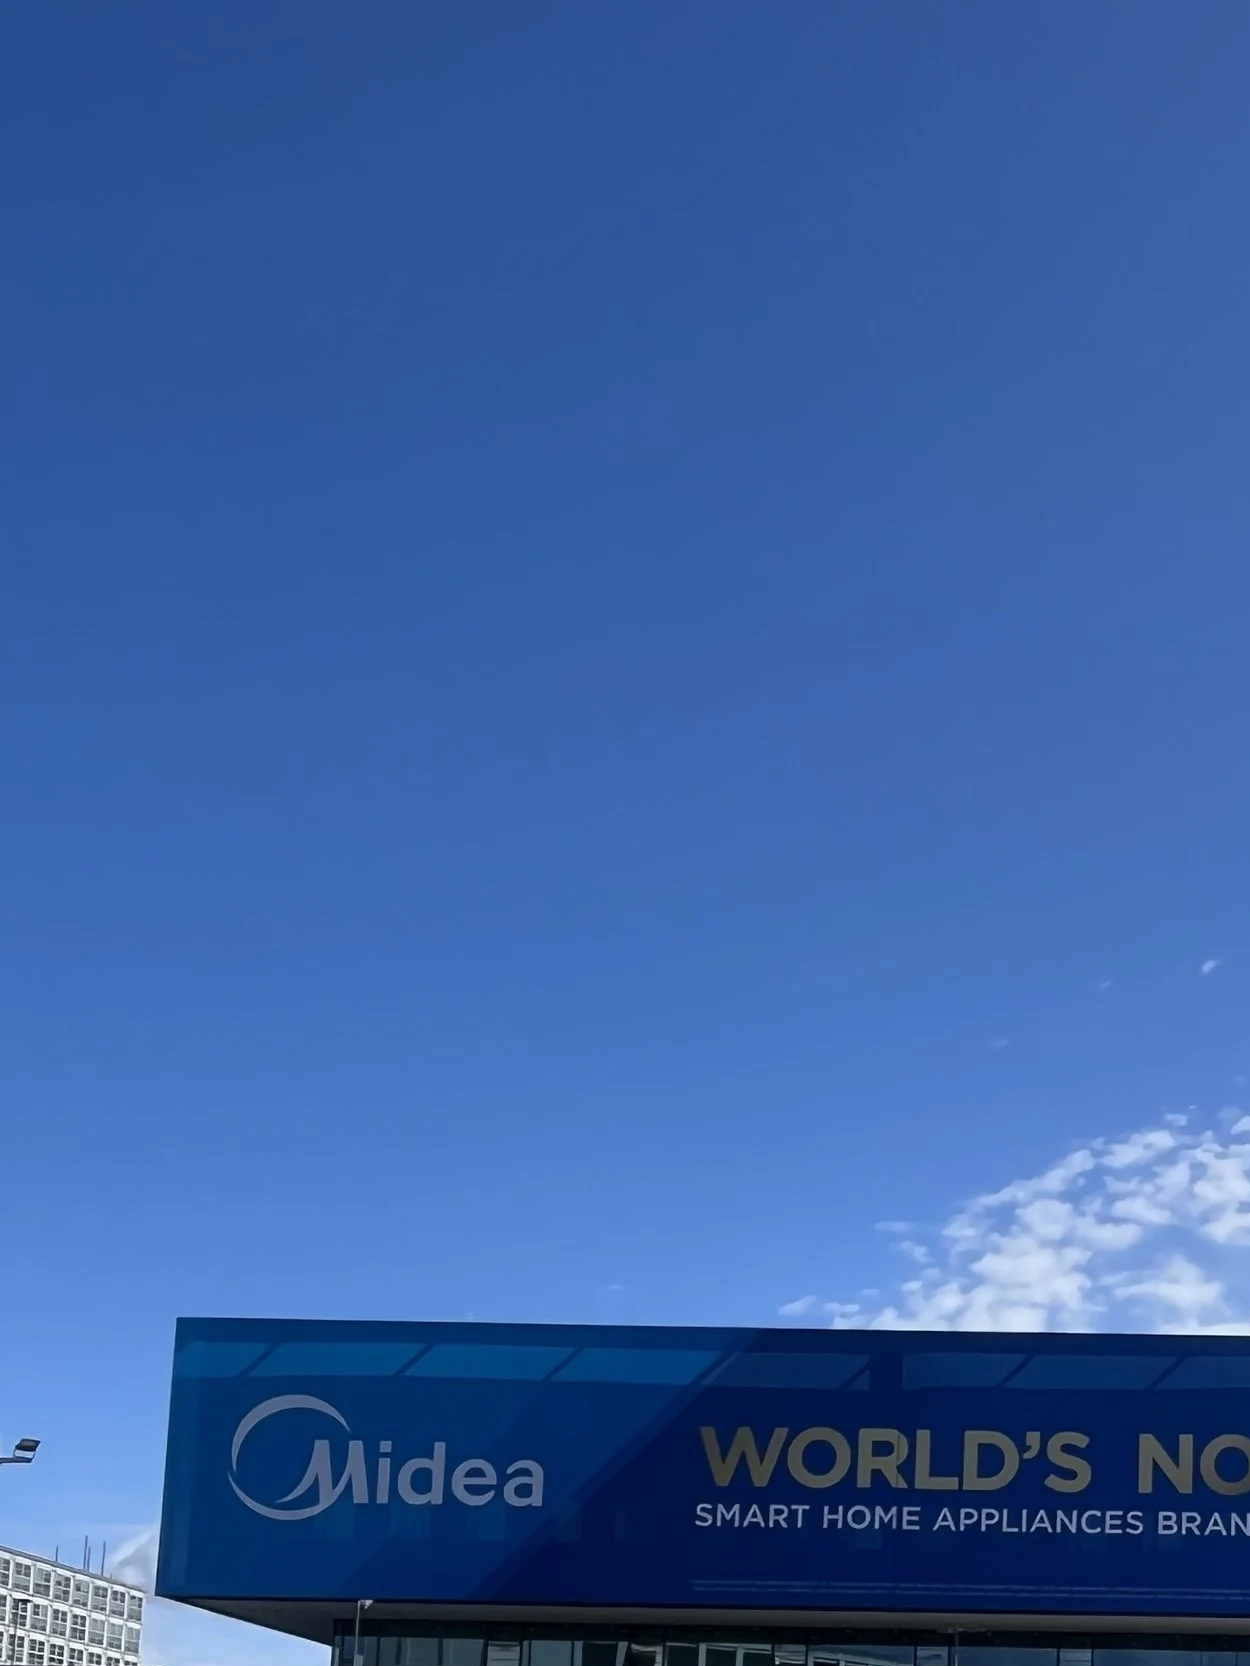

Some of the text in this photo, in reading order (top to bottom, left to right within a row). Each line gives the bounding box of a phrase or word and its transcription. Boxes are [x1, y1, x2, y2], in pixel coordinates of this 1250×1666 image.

[227, 1394, 544, 1521] Midea
[702, 1426, 1092, 1493] WORLD'S
[695, 1503, 810, 1529] SMART
[822, 1505, 921, 1531] HOME
[932, 1507, 1144, 1535] APPLIANCES
